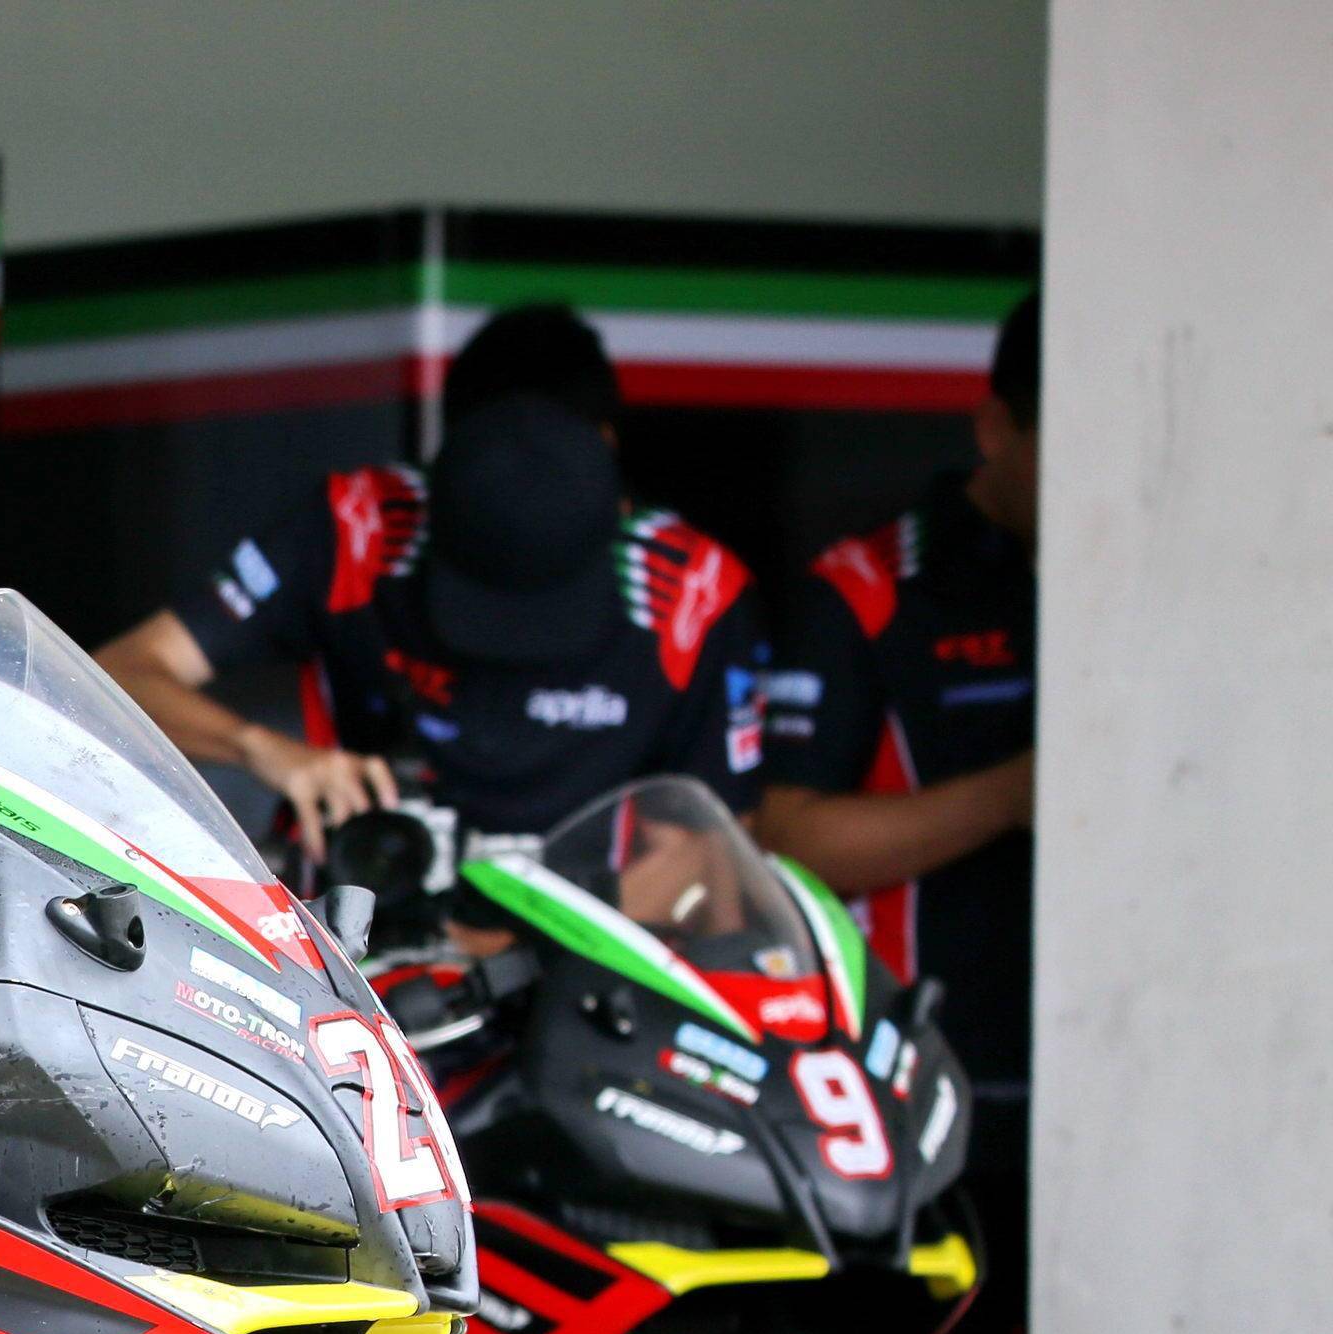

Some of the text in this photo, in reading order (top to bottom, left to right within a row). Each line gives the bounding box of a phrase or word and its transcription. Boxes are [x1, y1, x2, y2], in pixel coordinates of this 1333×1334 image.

[175, 979, 306, 1058] MOTO-TRON
[237, 1027, 306, 1065] RACING
[792, 1049, 892, 1179] 9
